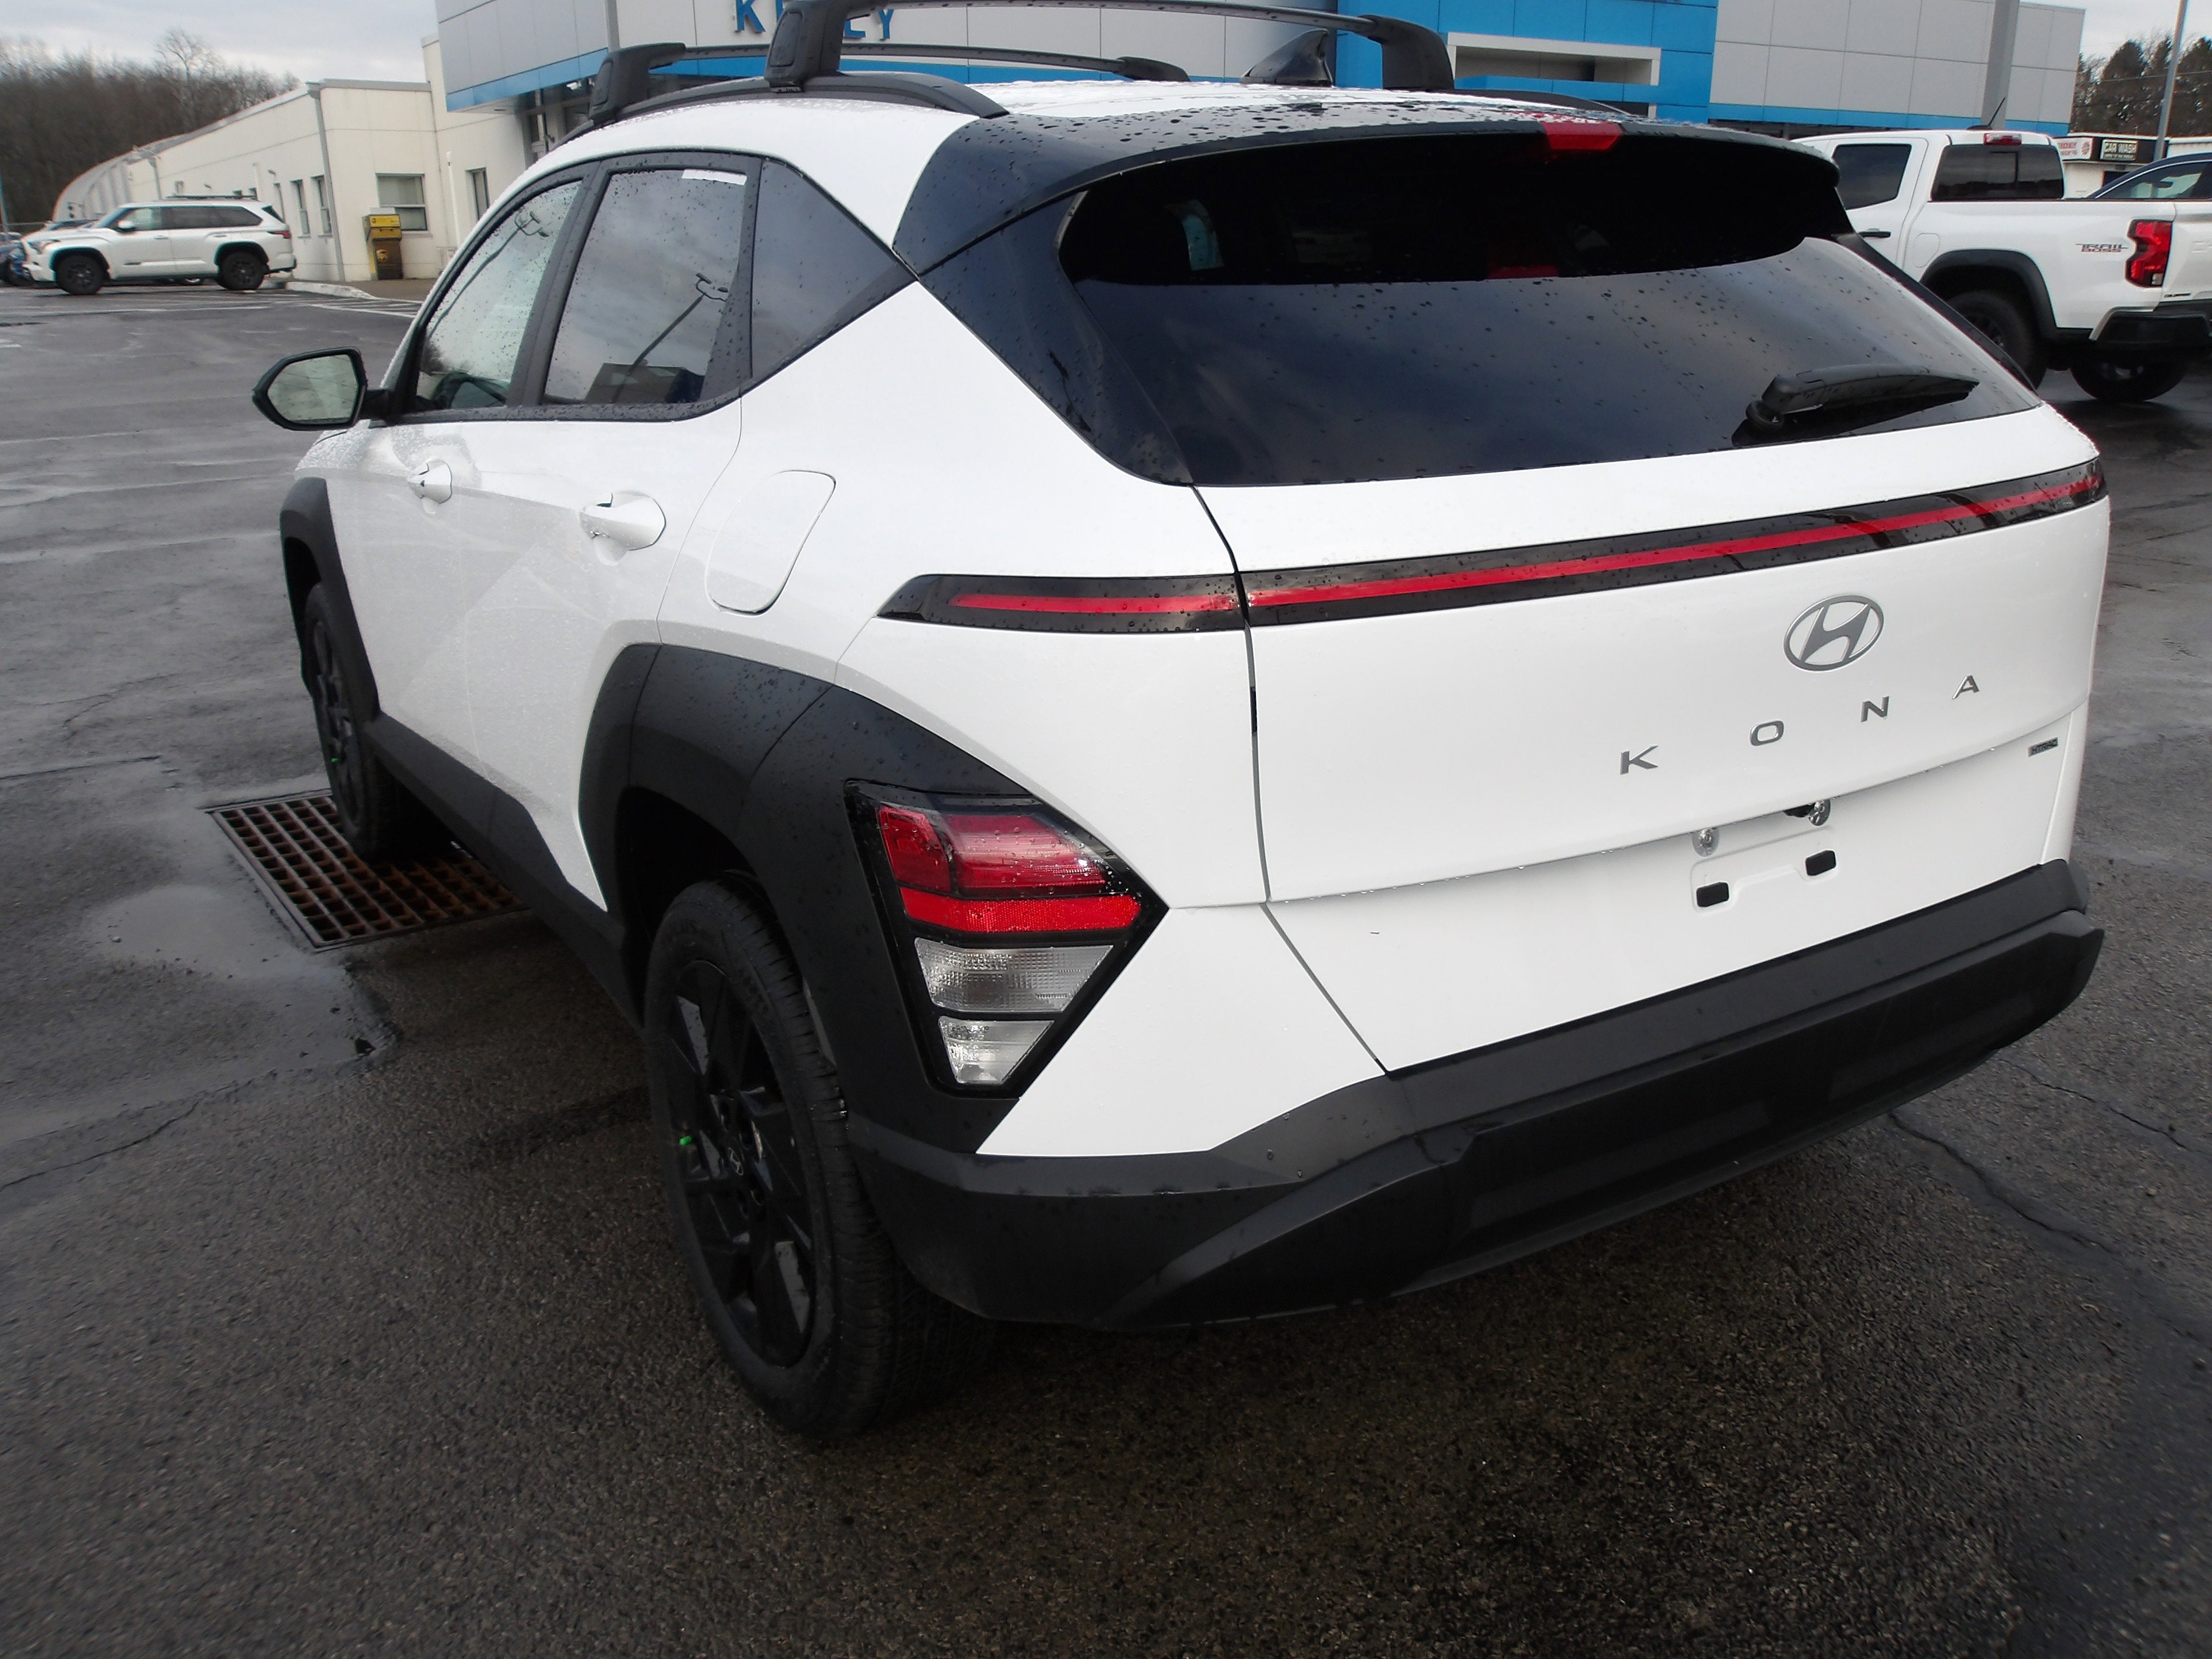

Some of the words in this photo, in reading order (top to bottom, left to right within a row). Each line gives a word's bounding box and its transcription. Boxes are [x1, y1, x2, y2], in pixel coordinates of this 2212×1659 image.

[2104, 142, 2117, 153] CAR
[2118, 143, 2136, 154] WASH
[1620, 674, 1980, 775] KONA
